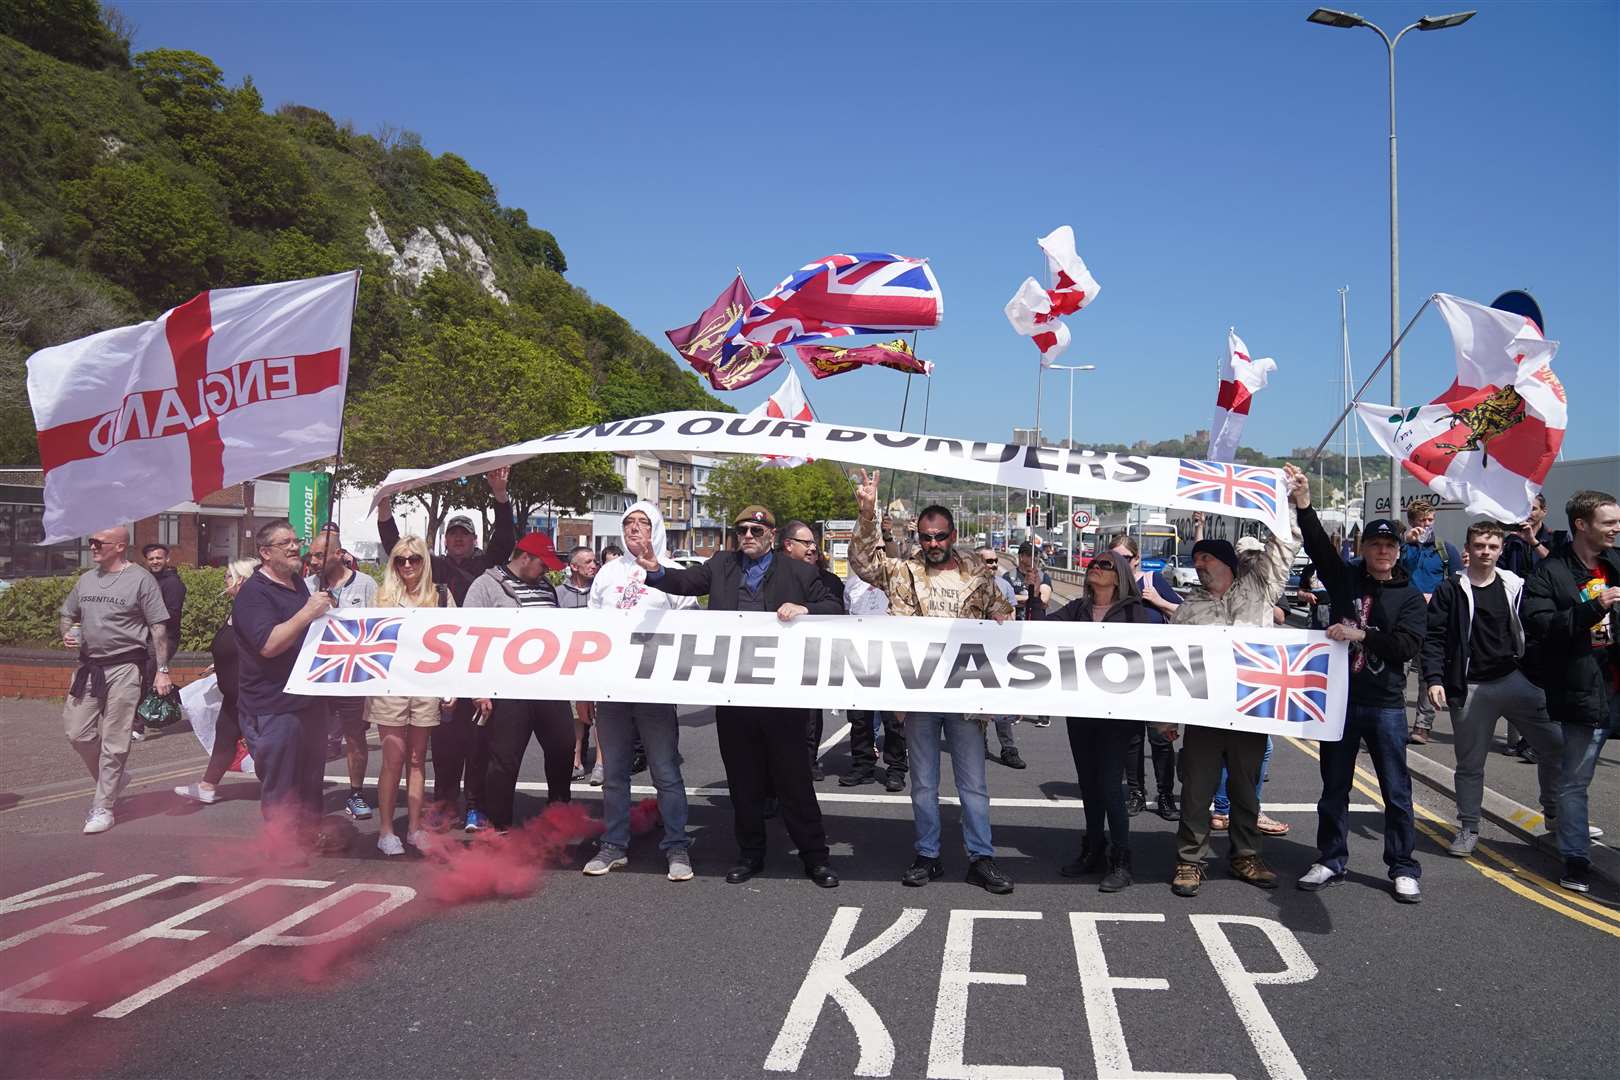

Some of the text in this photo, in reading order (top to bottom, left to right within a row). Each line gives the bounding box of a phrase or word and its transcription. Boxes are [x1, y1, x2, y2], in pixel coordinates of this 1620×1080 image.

[677, 417, 812, 438] OUR
[1075, 515, 1088, 523] 40
[414, 624, 1208, 699] STOP THE INVASION
[763, 906, 1319, 1080] KEEP
